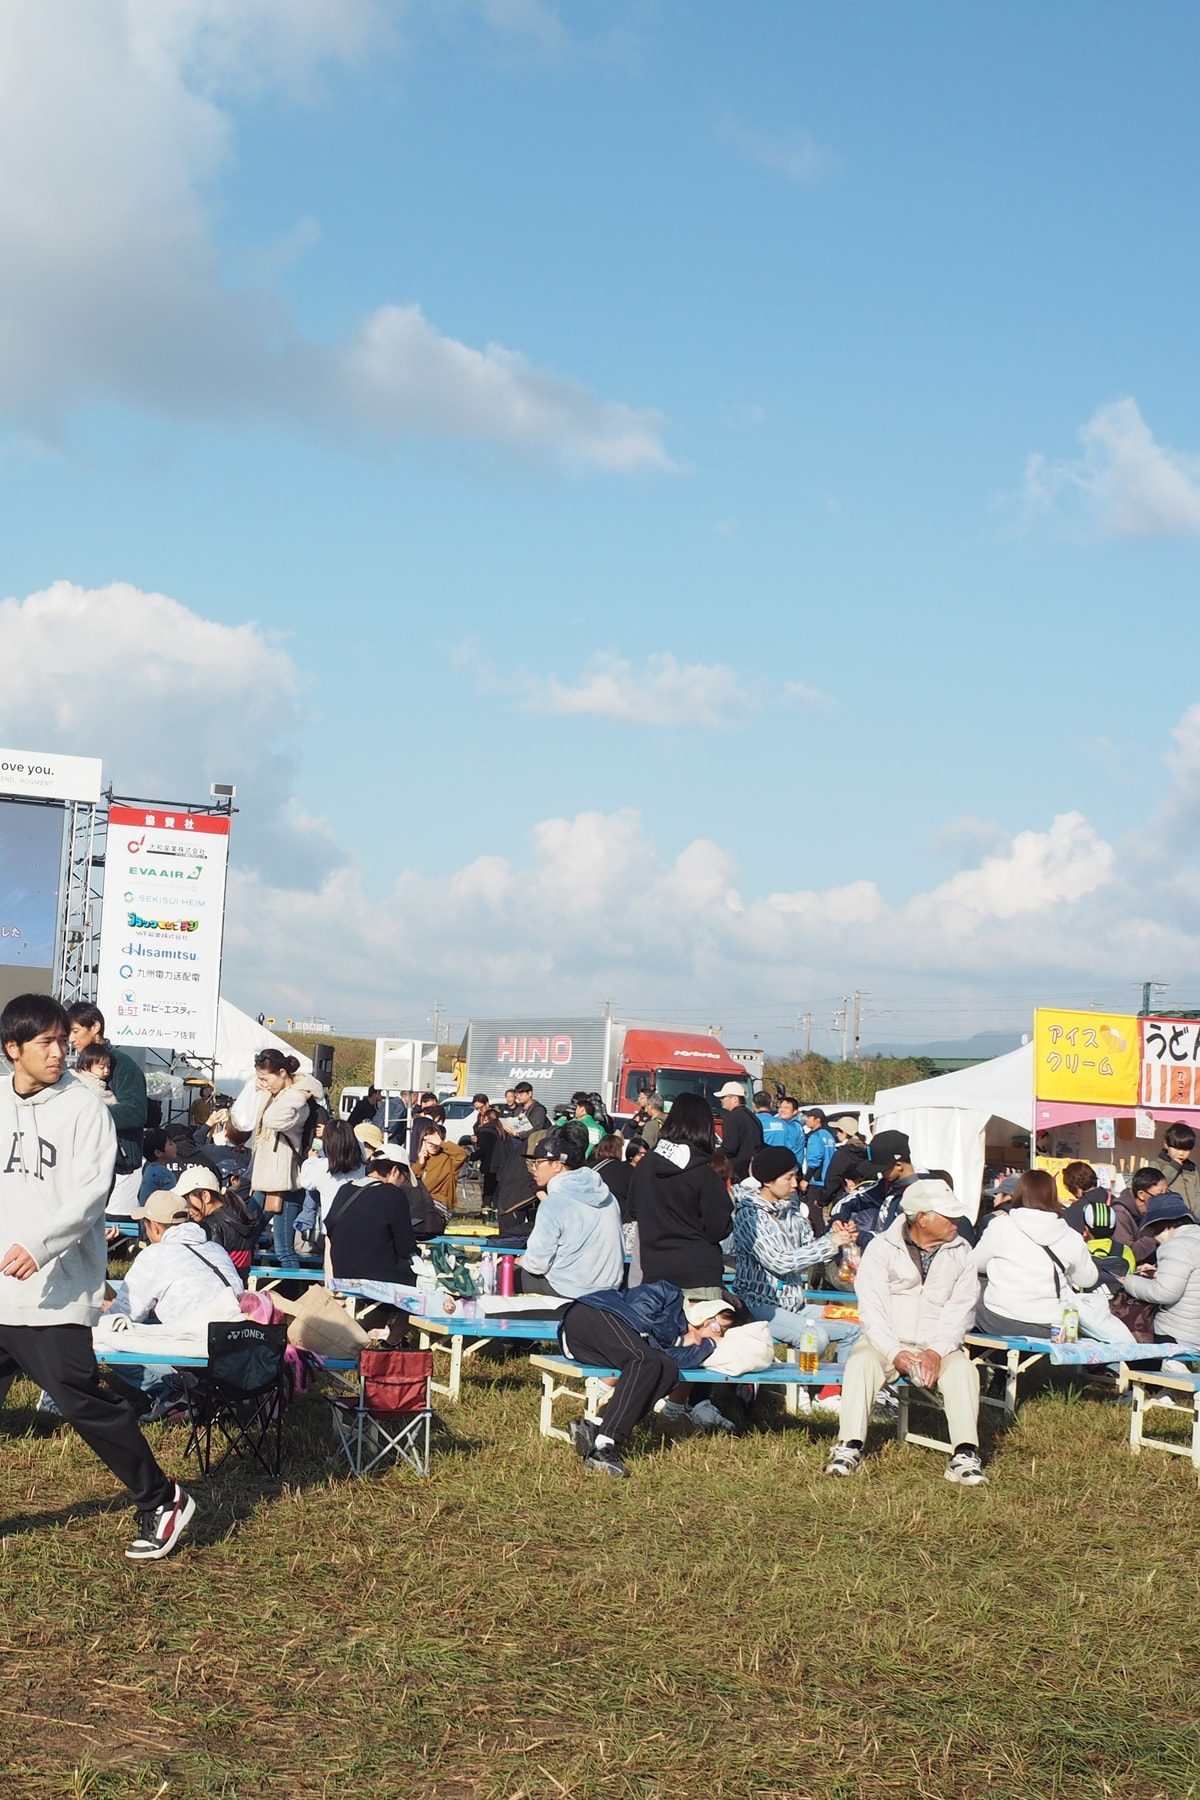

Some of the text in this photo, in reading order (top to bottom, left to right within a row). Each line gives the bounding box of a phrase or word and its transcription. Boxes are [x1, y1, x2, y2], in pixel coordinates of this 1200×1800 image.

[27, 763, 55, 776] you.
[129, 867, 184, 879] EVA AIR
[138, 895, 206, 907] SEKISUI HEIM
[121, 942, 197, 961] Hisamitsu
[136, 969, 200, 982] 九州電力送配電
[1048, 1024, 1099, 1049] アイス
[497, 1034, 572, 1065] HINO
[1047, 1051, 1114, 1076] クリーム
[509, 1068, 554, 1079] Hybrid
[241, 1328, 265, 1340] YONEX
